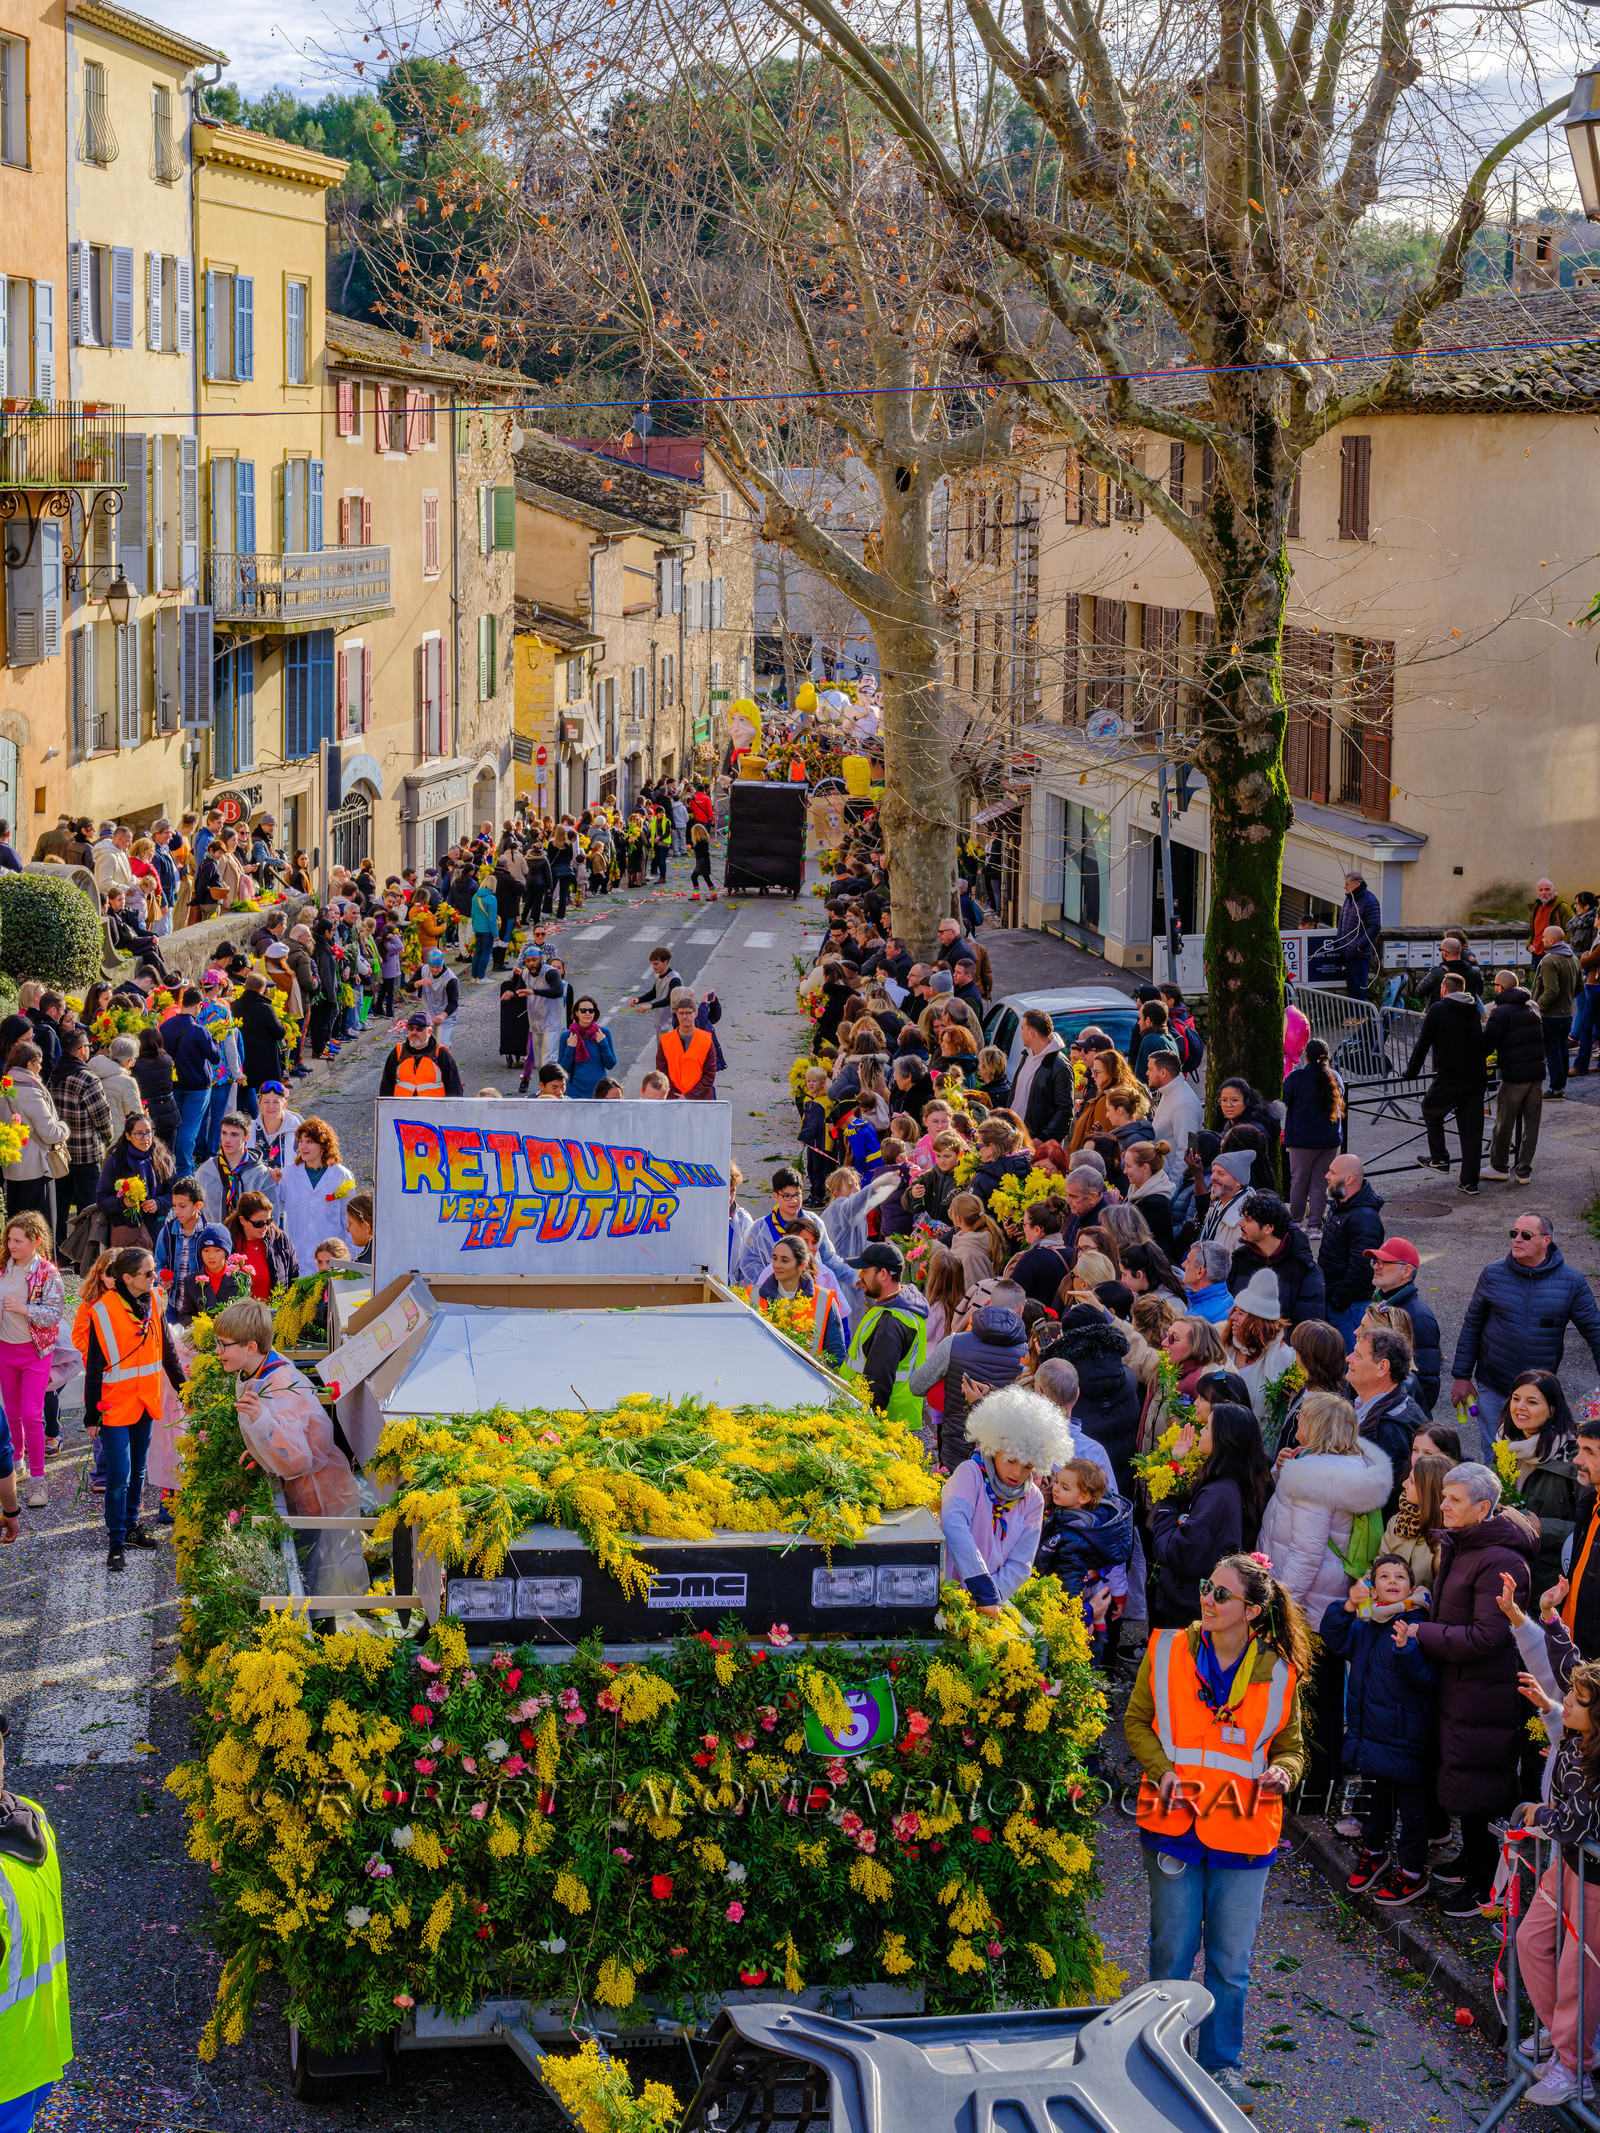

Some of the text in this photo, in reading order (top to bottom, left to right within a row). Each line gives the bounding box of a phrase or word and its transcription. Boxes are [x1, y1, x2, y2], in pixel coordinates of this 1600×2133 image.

[711, 691, 728, 699] CBD
[216, 792, 242, 804] BARNES
[224, 801, 237, 820] B
[394, 1119, 677, 1195] RETOUR
[438, 1195, 510, 1223] VERS
[495, 1194, 679, 1248] FUTUR
[459, 1220, 504, 1251] LE
[712, 1599, 745, 1607] COMPANY
